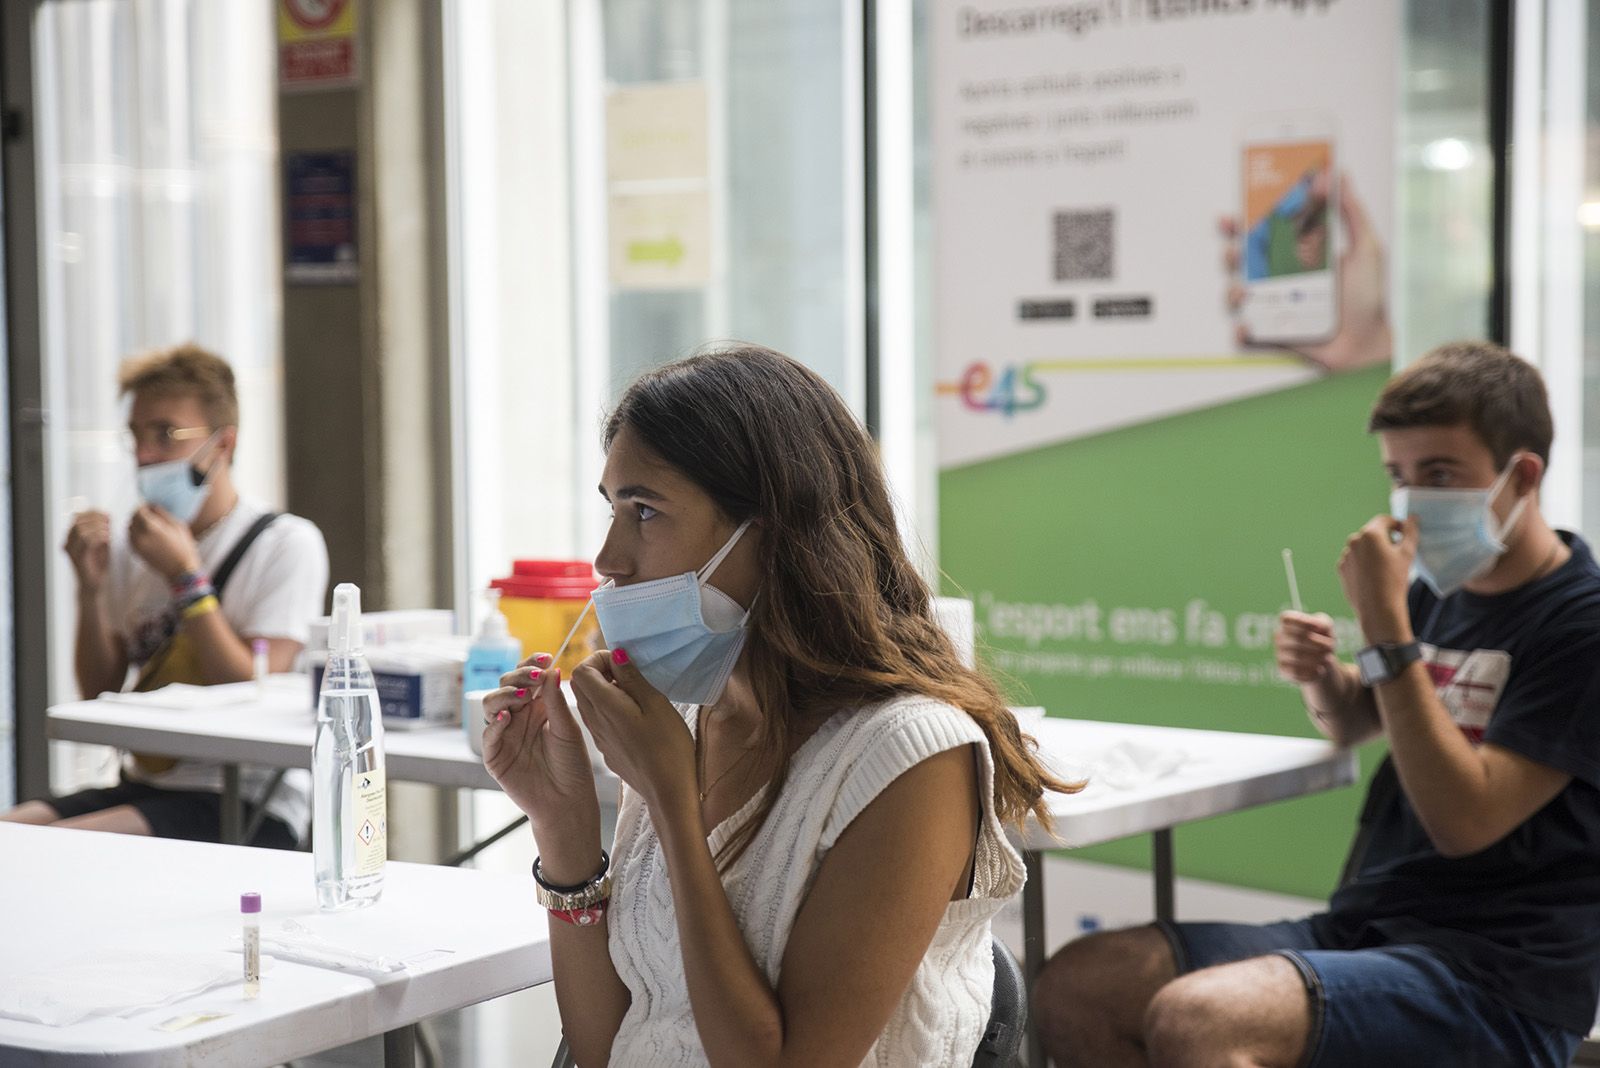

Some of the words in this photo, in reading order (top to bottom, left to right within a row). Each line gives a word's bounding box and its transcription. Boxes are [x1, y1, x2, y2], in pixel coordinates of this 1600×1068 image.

[981, 592, 1102, 646] 'esport
[1109, 606, 1176, 646] ens
[1185, 598, 1228, 648] fa
